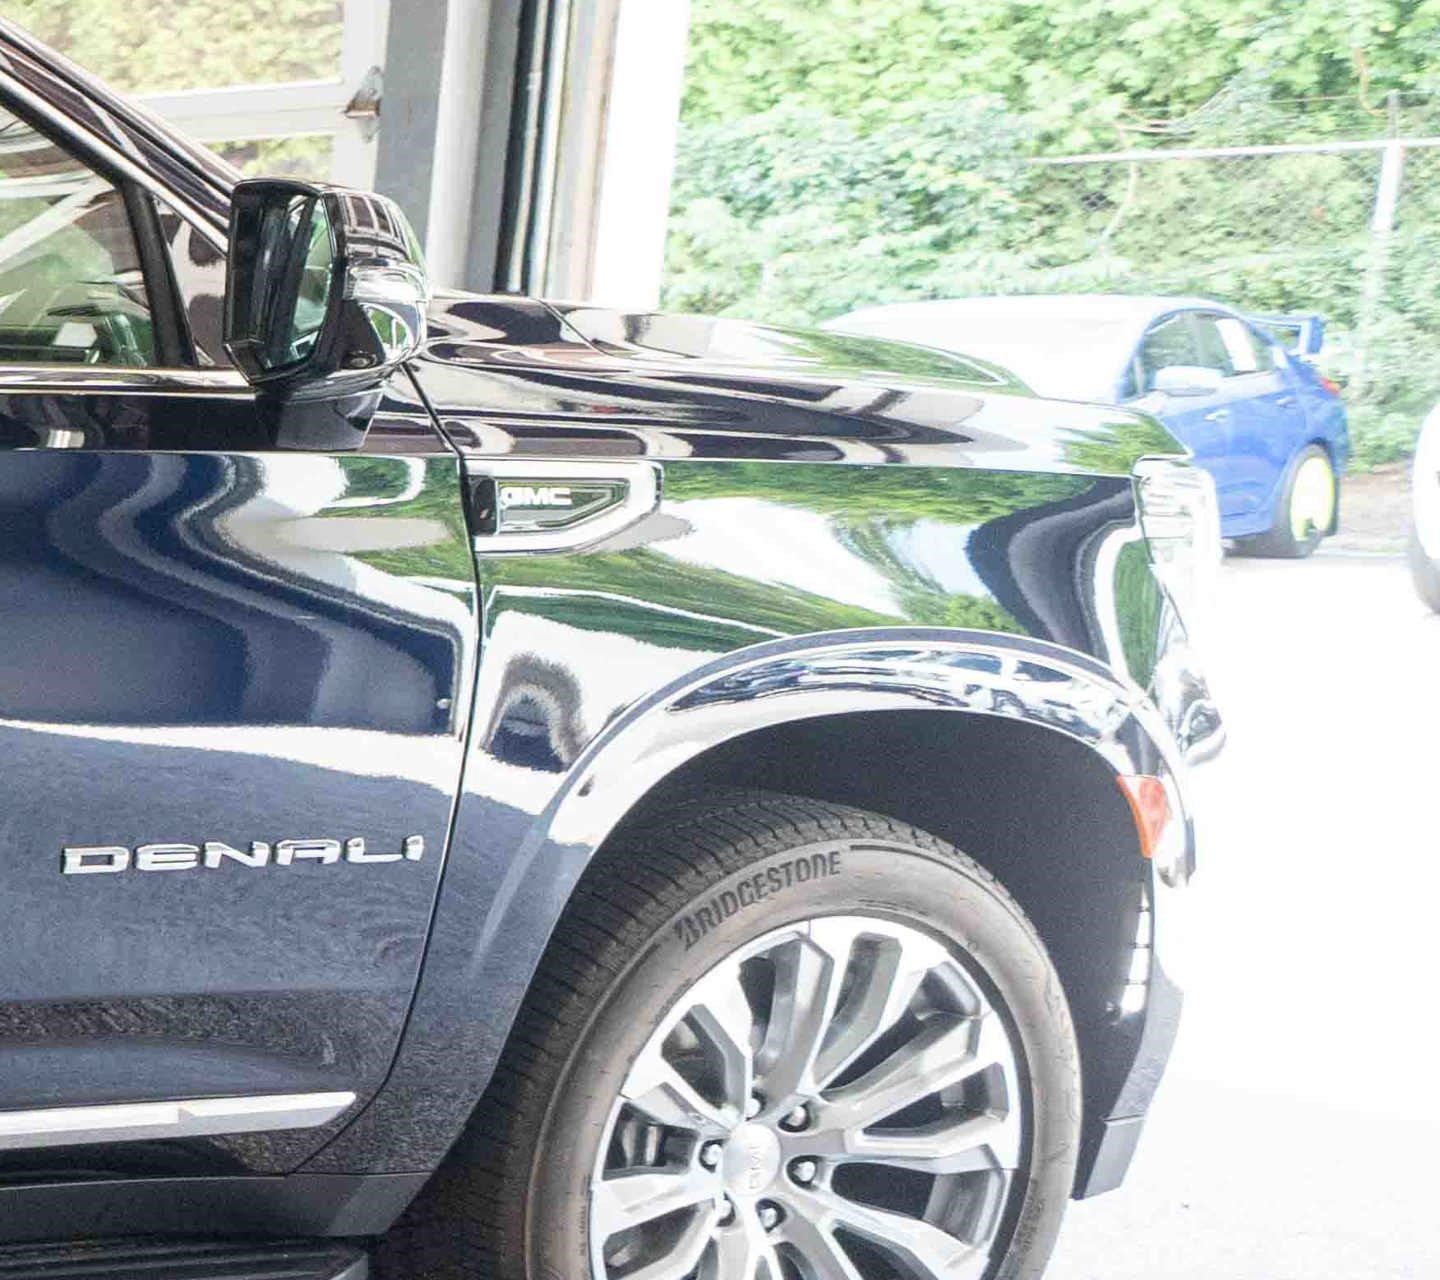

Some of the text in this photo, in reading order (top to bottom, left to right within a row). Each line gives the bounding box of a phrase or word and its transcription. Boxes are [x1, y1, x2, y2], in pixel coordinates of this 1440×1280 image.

[500, 486, 572, 510] GMC
[62, 834, 422, 874] DENALI
[674, 851, 841, 952] BRIDGESTONE
